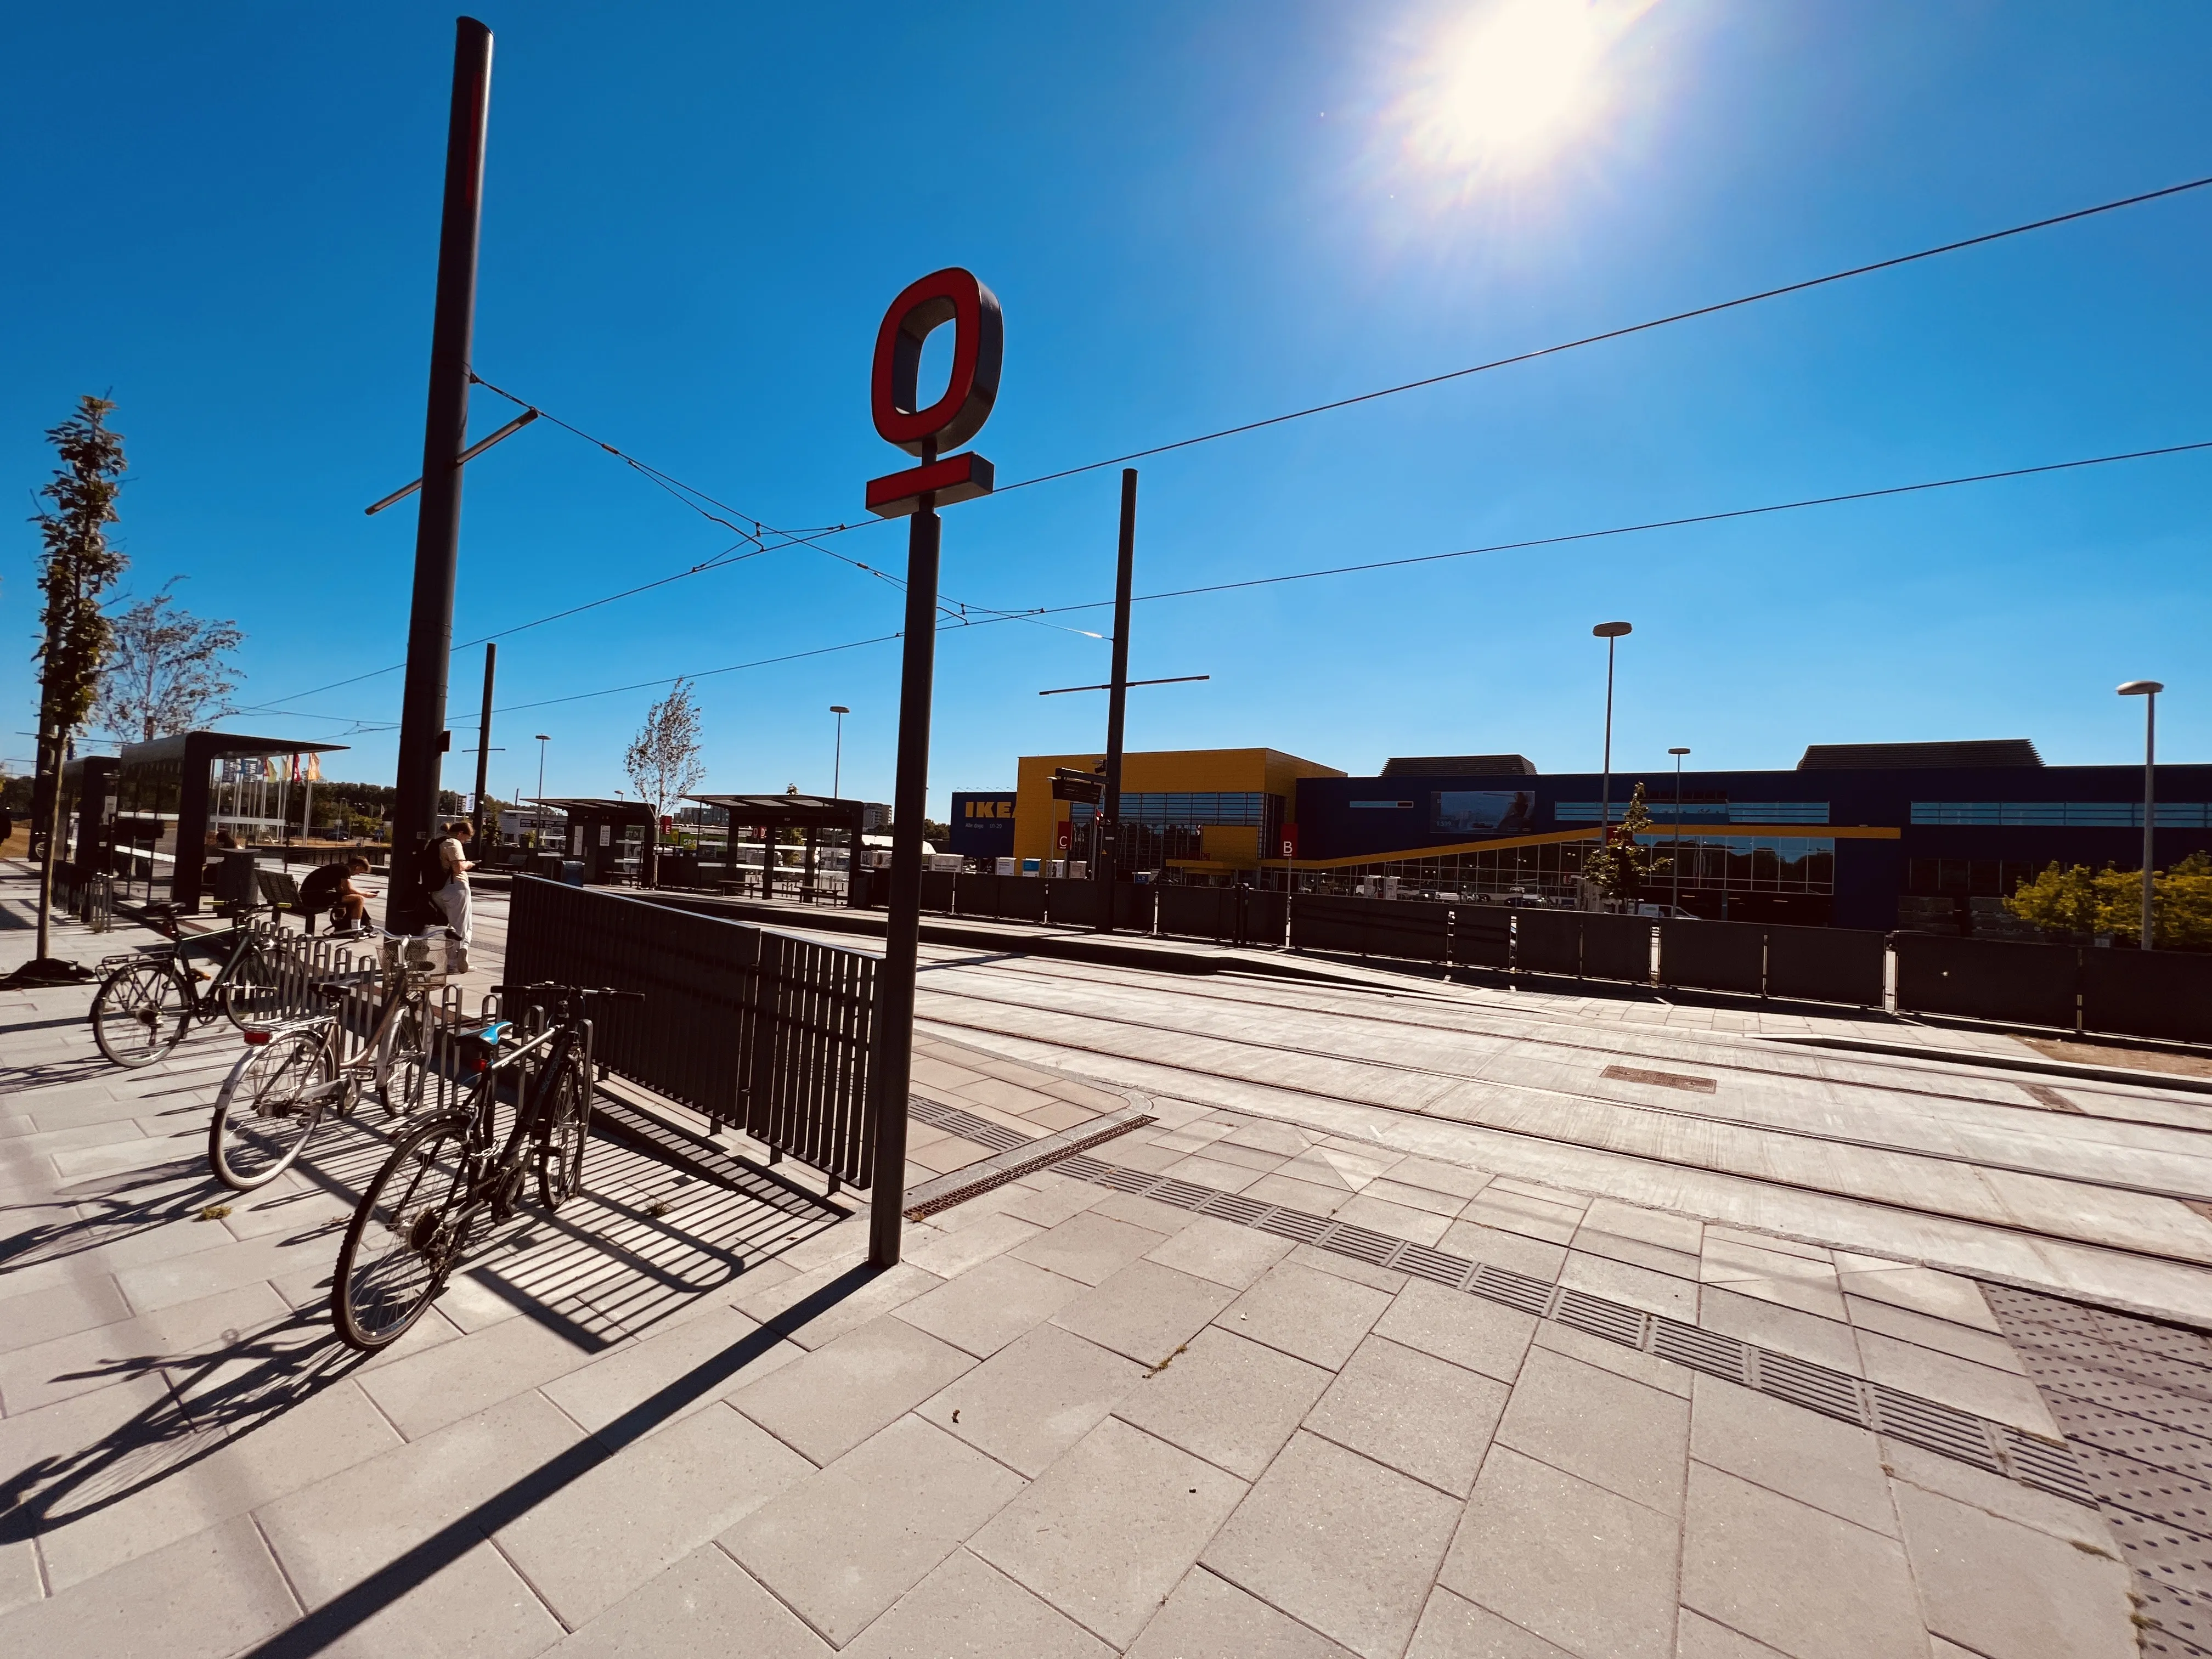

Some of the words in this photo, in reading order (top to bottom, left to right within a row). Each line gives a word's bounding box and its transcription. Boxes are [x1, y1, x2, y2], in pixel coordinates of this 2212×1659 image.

[965, 802, 1015, 818] IKE
[1059, 836, 1068, 847] C
[1283, 841, 1292, 854] B
